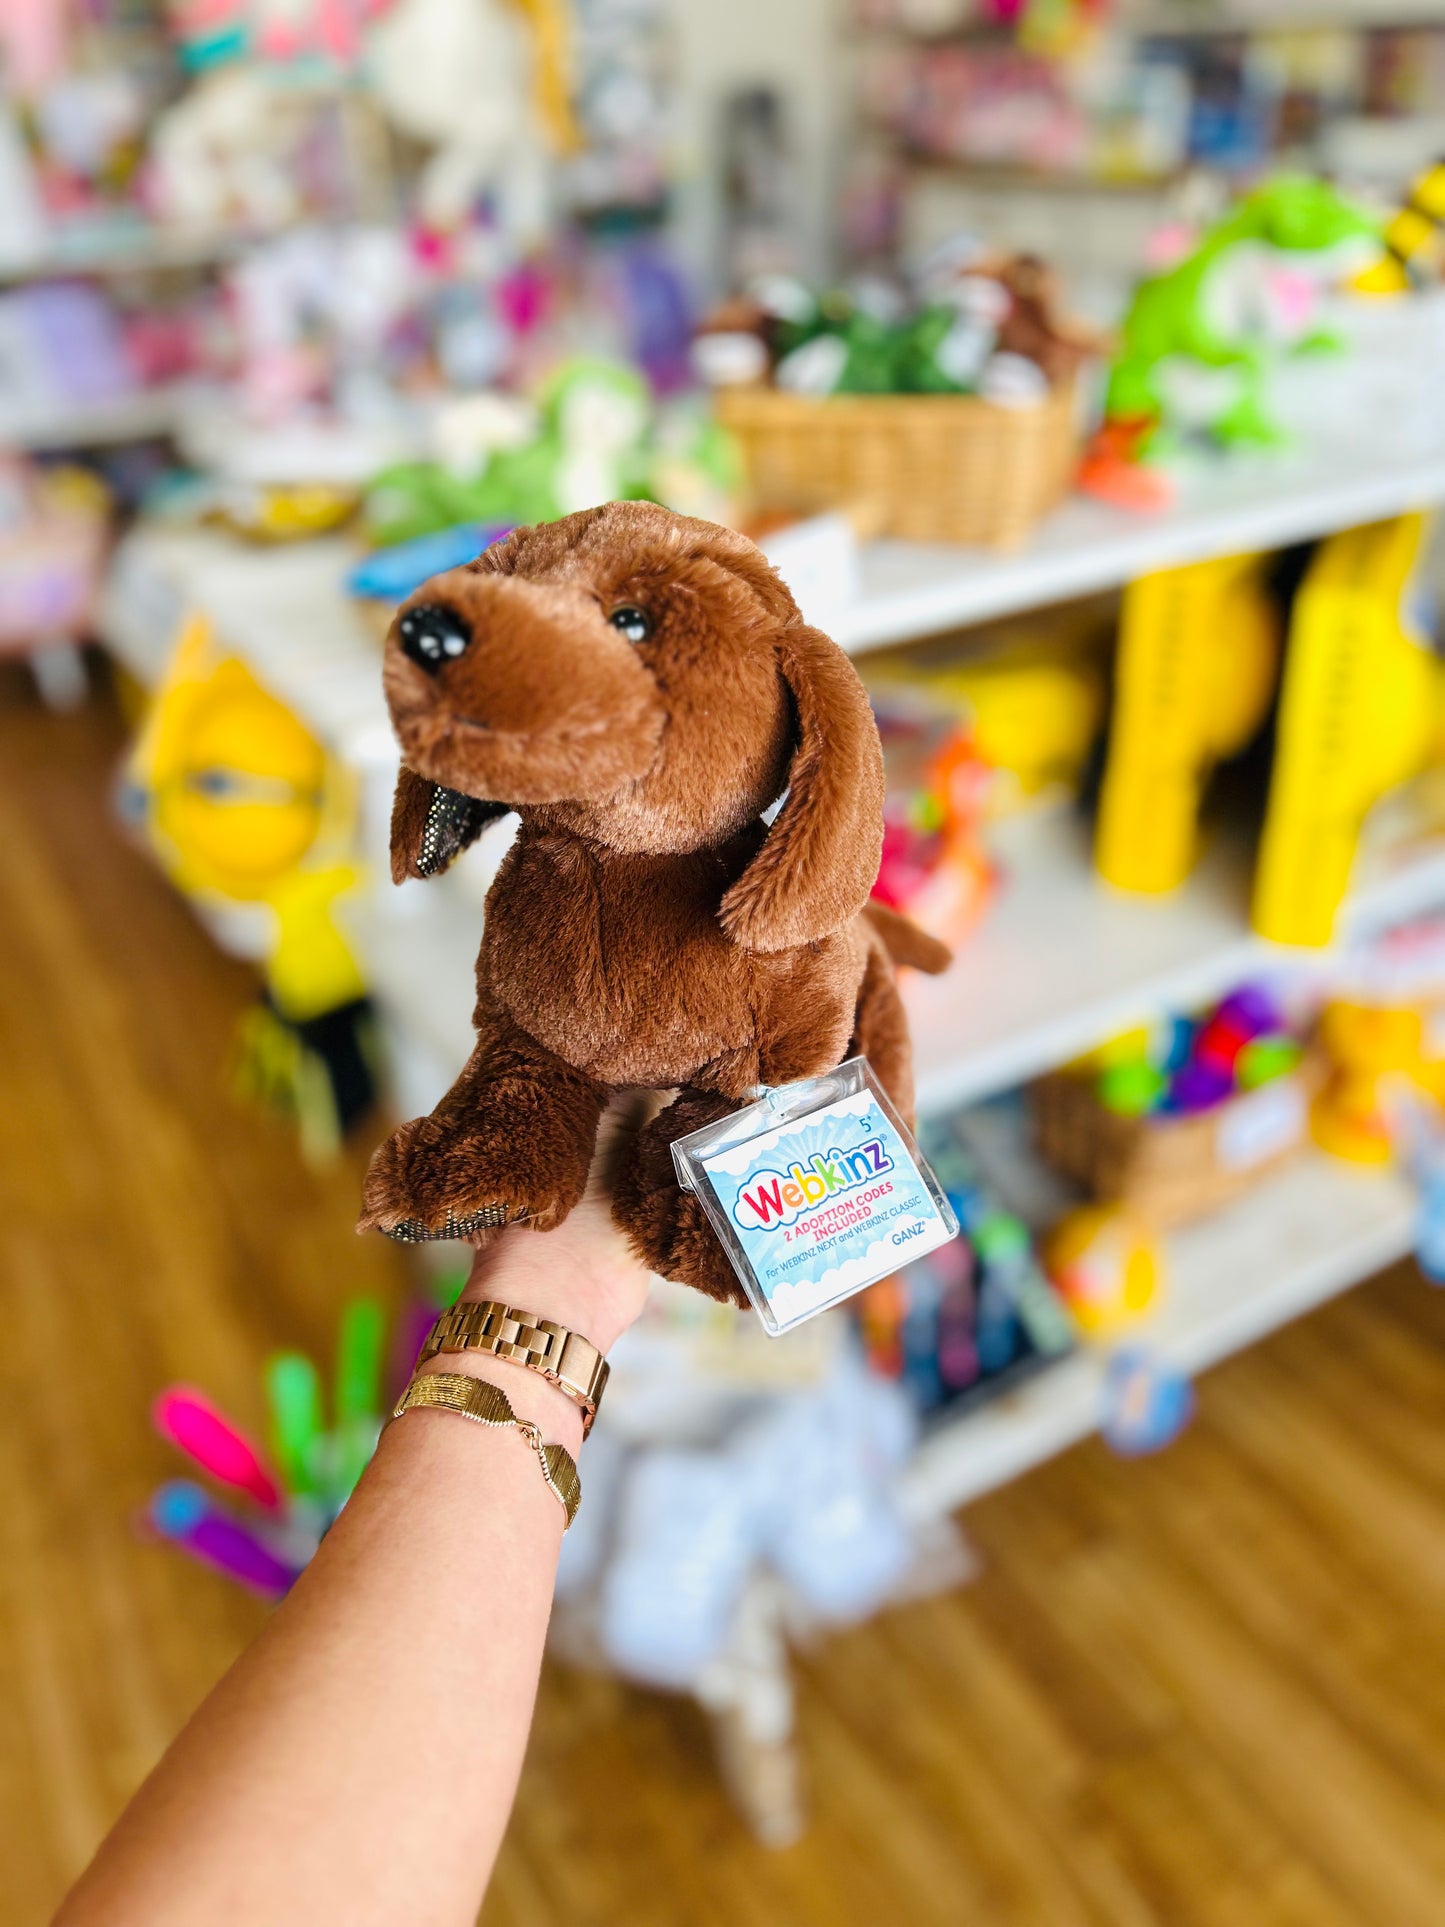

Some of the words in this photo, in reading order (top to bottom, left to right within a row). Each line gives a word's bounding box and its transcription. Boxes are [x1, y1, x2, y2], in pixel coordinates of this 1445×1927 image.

[743, 1142, 889, 1223] Webkinz
[784, 1231, 792, 1242] 2
[795, 1203, 855, 1237] ADOPTION
[856, 1182, 893, 1205] CODES
[766, 1268, 779, 1279] For
[780, 1248, 817, 1271] WEBKINZ
[817, 1238, 838, 1254] NEXT
[838, 1230, 854, 1244] and
[853, 1213, 890, 1238] WEBKINZ
[889, 1196, 922, 1217] CLASSIC
[814, 1206, 872, 1242] INCLUDED
